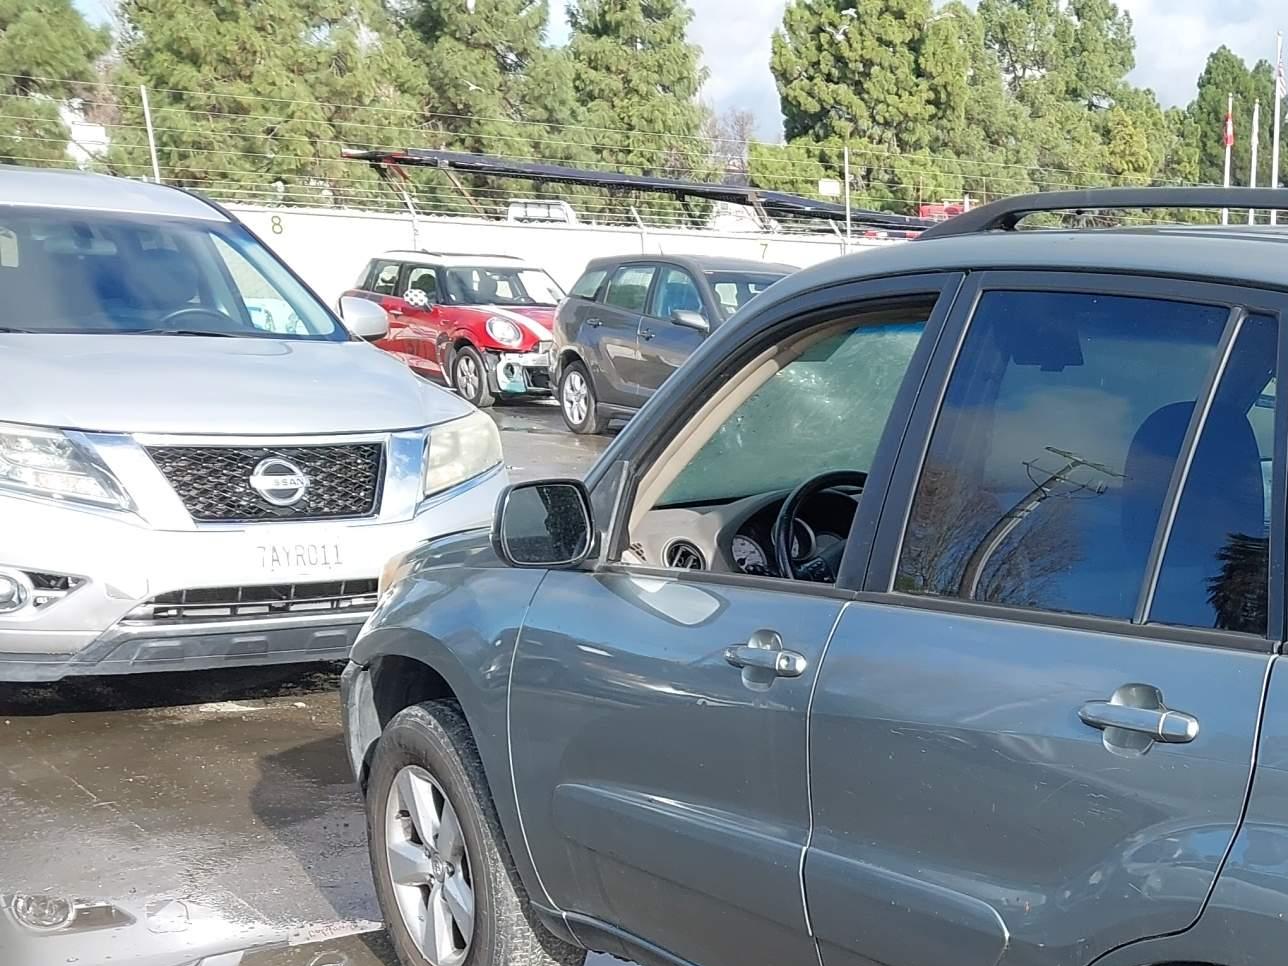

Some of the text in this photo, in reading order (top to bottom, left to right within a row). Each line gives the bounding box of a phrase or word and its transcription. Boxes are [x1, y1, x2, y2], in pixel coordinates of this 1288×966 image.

[271, 215, 283, 234] 8
[760, 243, 768, 260] 7
[256, 543, 343, 568] 7AYR011
